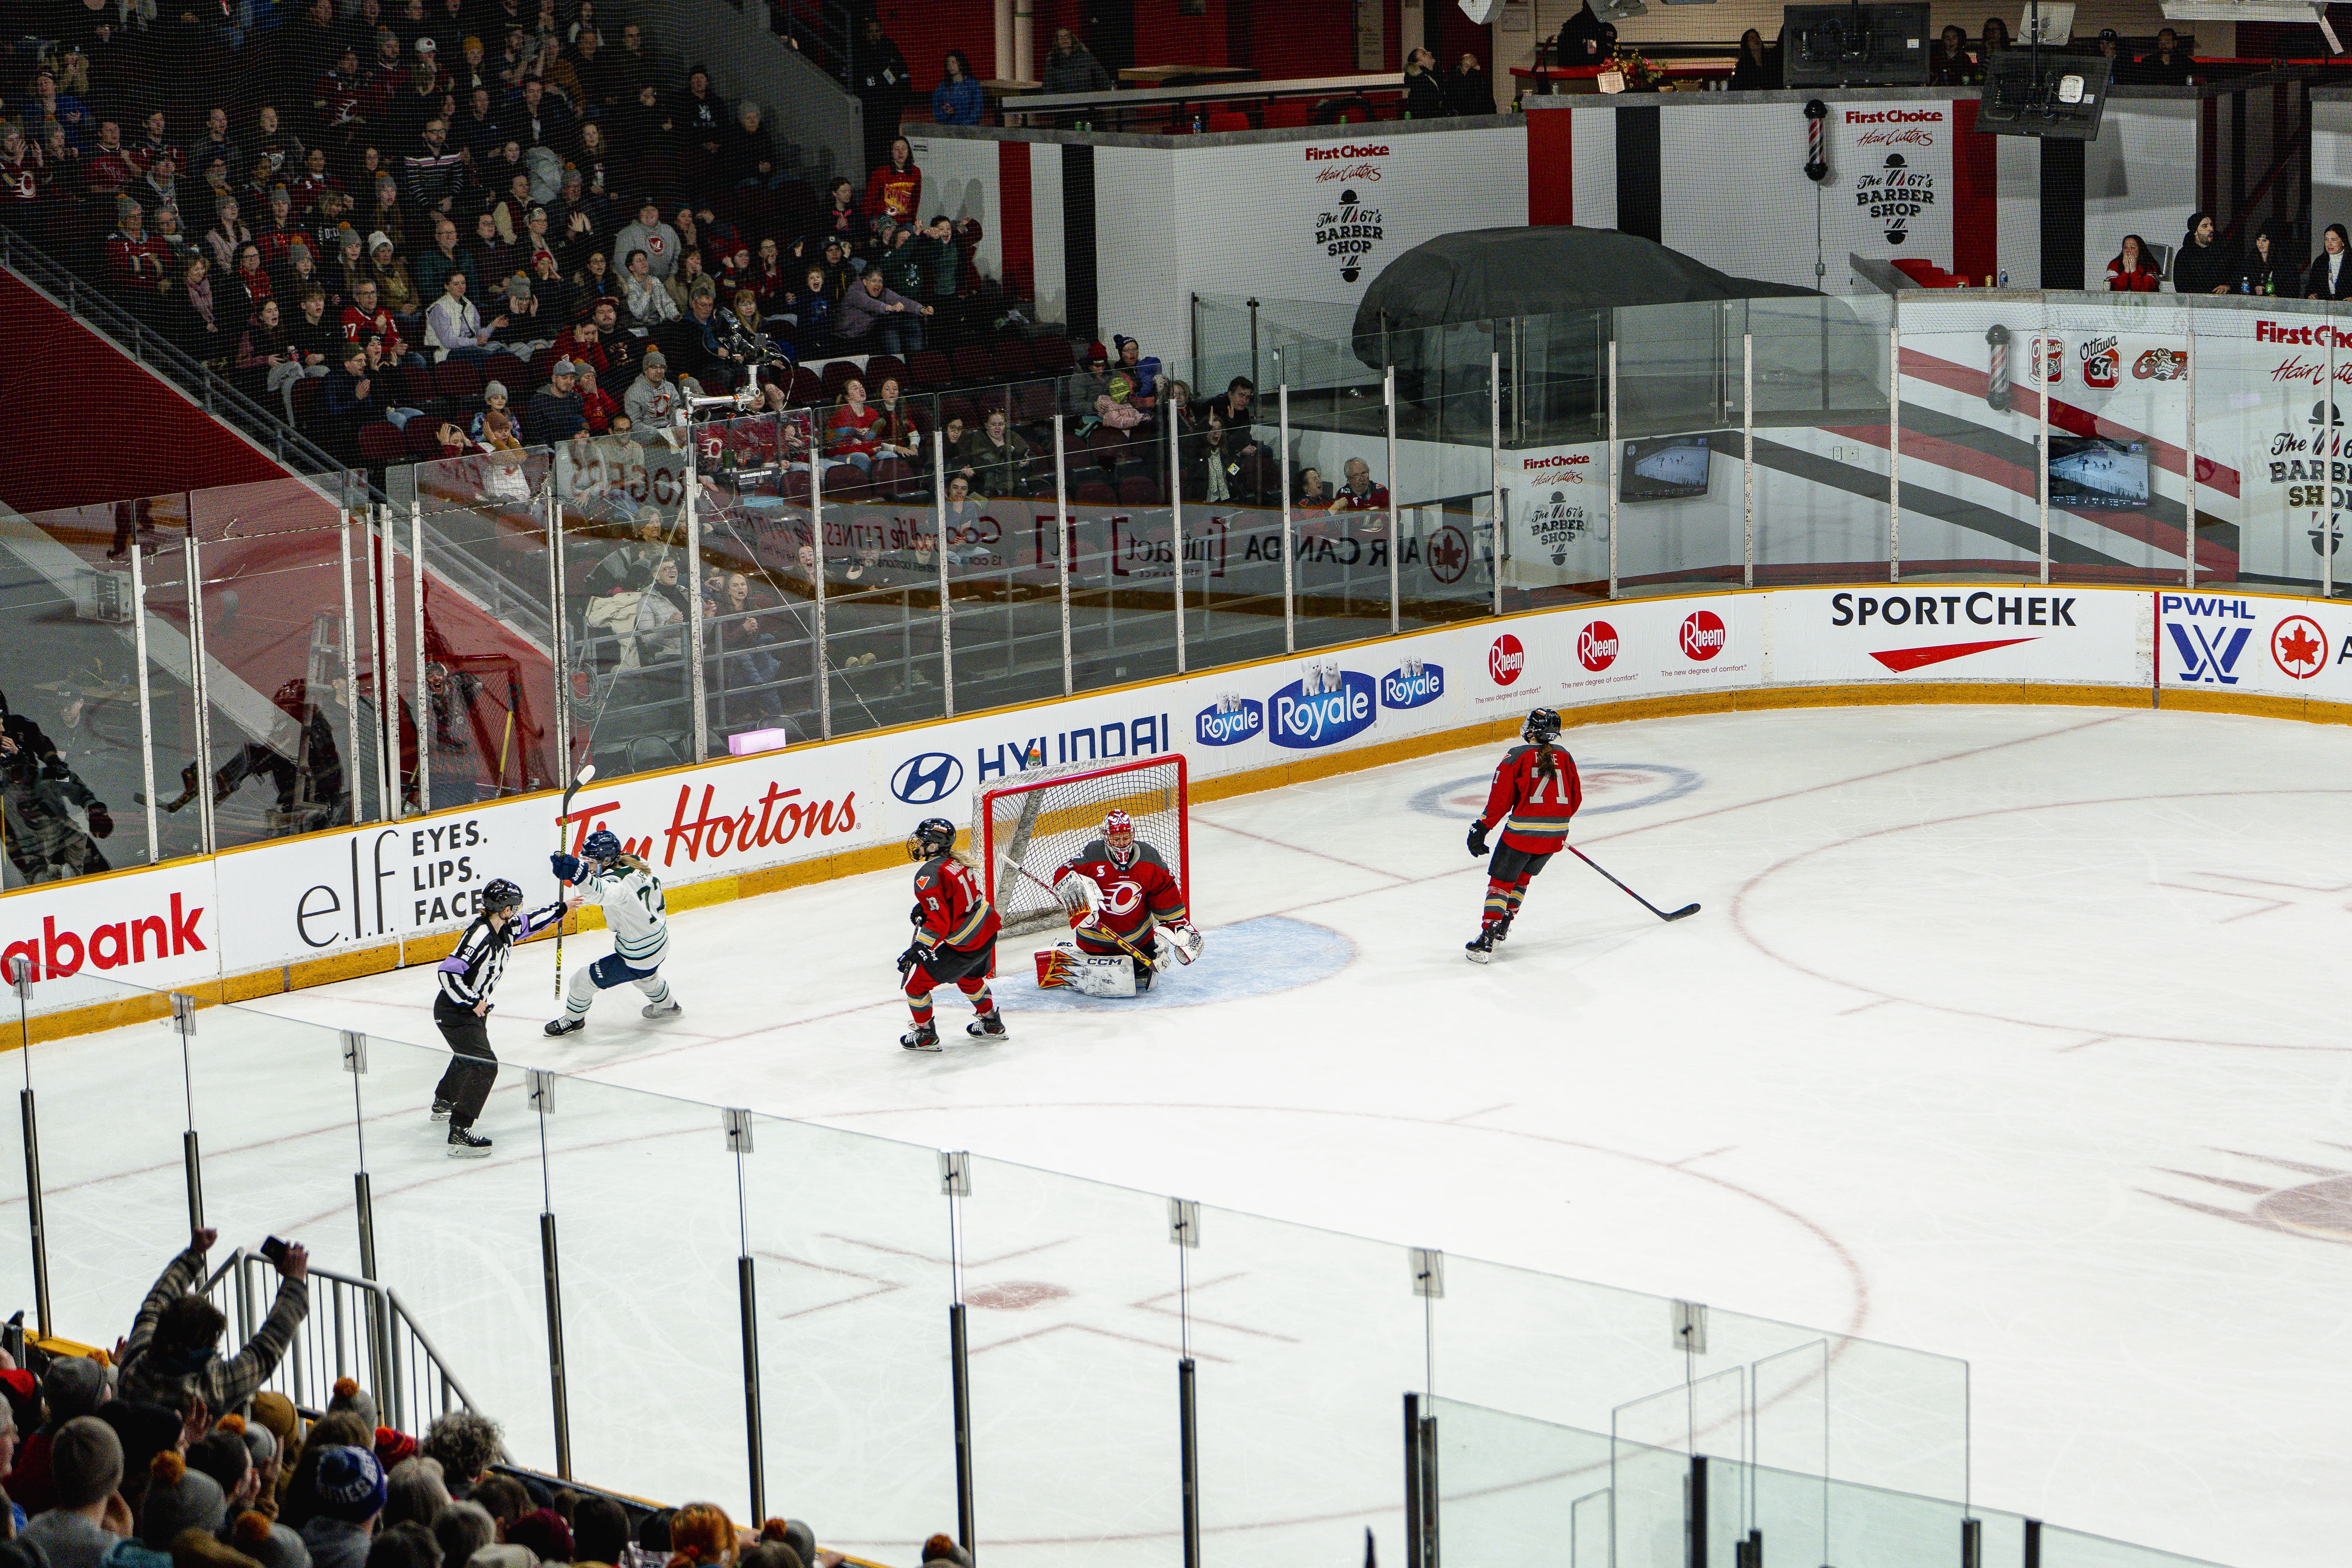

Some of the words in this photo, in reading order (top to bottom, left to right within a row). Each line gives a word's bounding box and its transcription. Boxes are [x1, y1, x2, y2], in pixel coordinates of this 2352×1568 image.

[1846, 111, 1885, 124] First
[1886, 109, 1943, 123] Choice
[1306, 147, 1339, 161] First
[1341, 144, 1389, 158] Choice
[1857, 174, 1882, 189] The
[1907, 174, 1933, 188] 67's
[1856, 188, 1934, 206] BARBER
[1316, 212, 1338, 228] The
[1359, 209, 1382, 223] 67's
[1870, 203, 1921, 218] SHOP
[1315, 225, 1383, 244] BARBER
[1328, 240, 1372, 256] SHOP
[2256, 320, 2312, 345] First
[2080, 336, 2118, 360] Ottawa
[2271, 432, 2307, 456] The
[1524, 458, 1550, 470] First
[1551, 454, 1590, 466] Choice
[1532, 510, 1549, 523] The
[1566, 506, 1584, 518] 67's
[1531, 519, 1584, 536] BARBER
[1541, 532, 1576, 545] SHOP
[2162, 596, 2256, 619] PWHL
[1581, 622, 1617, 665] Rheem
[1684, 611, 1724, 654] Rheem
[1492, 637, 1524, 679] Rheem
[1386, 672, 1439, 704] Royale
[1496, 693, 1512, 701] degree
[1519, 687, 1540, 696] comfort.
[1278, 684, 1368, 741] Royale
[1201, 708, 1258, 741] Royale
[978, 713, 1169, 784] HYUNDAI
[1530, 767, 1569, 804] 71
[664, 781, 856, 867] Hortons
[412, 820, 488, 857] EYES.
[414, 856, 481, 891] LIPS.
[1056, 873, 1073, 891] CCM
[464, 946, 475, 956] 40
[1101, 927, 1152, 967] CCM
